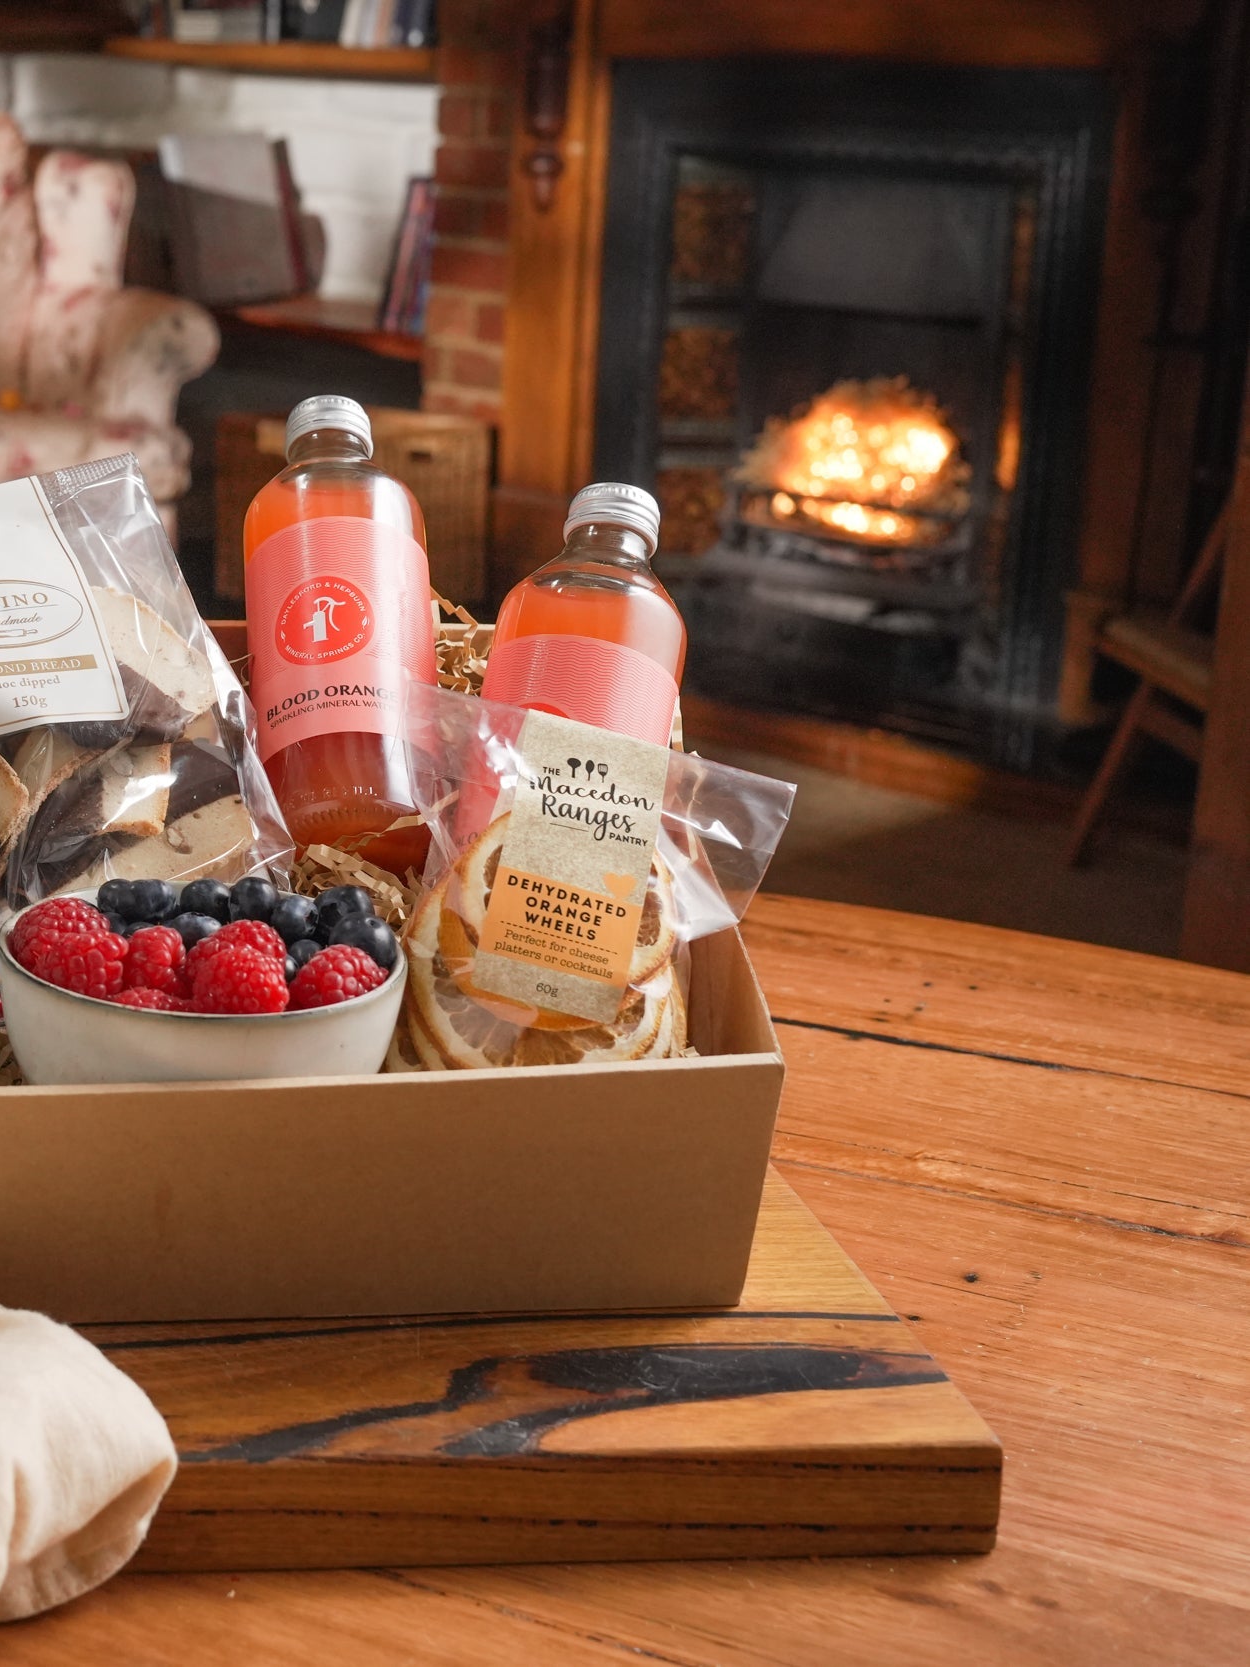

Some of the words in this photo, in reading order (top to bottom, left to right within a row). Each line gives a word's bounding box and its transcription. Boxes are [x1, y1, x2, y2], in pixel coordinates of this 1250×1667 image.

[281, 582, 322, 625] DAYLESFORD
[333, 583, 366, 612] HEPBURN
[31, 658, 81, 672] BREAD
[285, 644, 314, 660] MINERAL
[317, 642, 354, 659] SPRINGS
[19, 675, 62, 689] dipped
[12, 695, 48, 709] 150g
[266, 688, 320, 722] BLOOD
[270, 704, 315, 730] SPARKLING
[316, 699, 361, 711] MINERAL
[542, 766, 561, 776] THE
[530, 774, 655, 811] Macedon
[542, 794, 636, 841] Ranges
[608, 831, 649, 848] PANTRY
[507, 874, 627, 919] DEHYDRATED
[525, 896, 603, 928] ORANGE
[525, 911, 597, 941] WHEELS
[493, 940, 542, 965] platters
[544, 955, 558, 965] or
[560, 956, 613, 980] cocktails
[504, 928, 547, 950] Perfect
[549, 940, 567, 954] for
[569, 945, 610, 966] cheese
[536, 982, 559, 998] 60g
